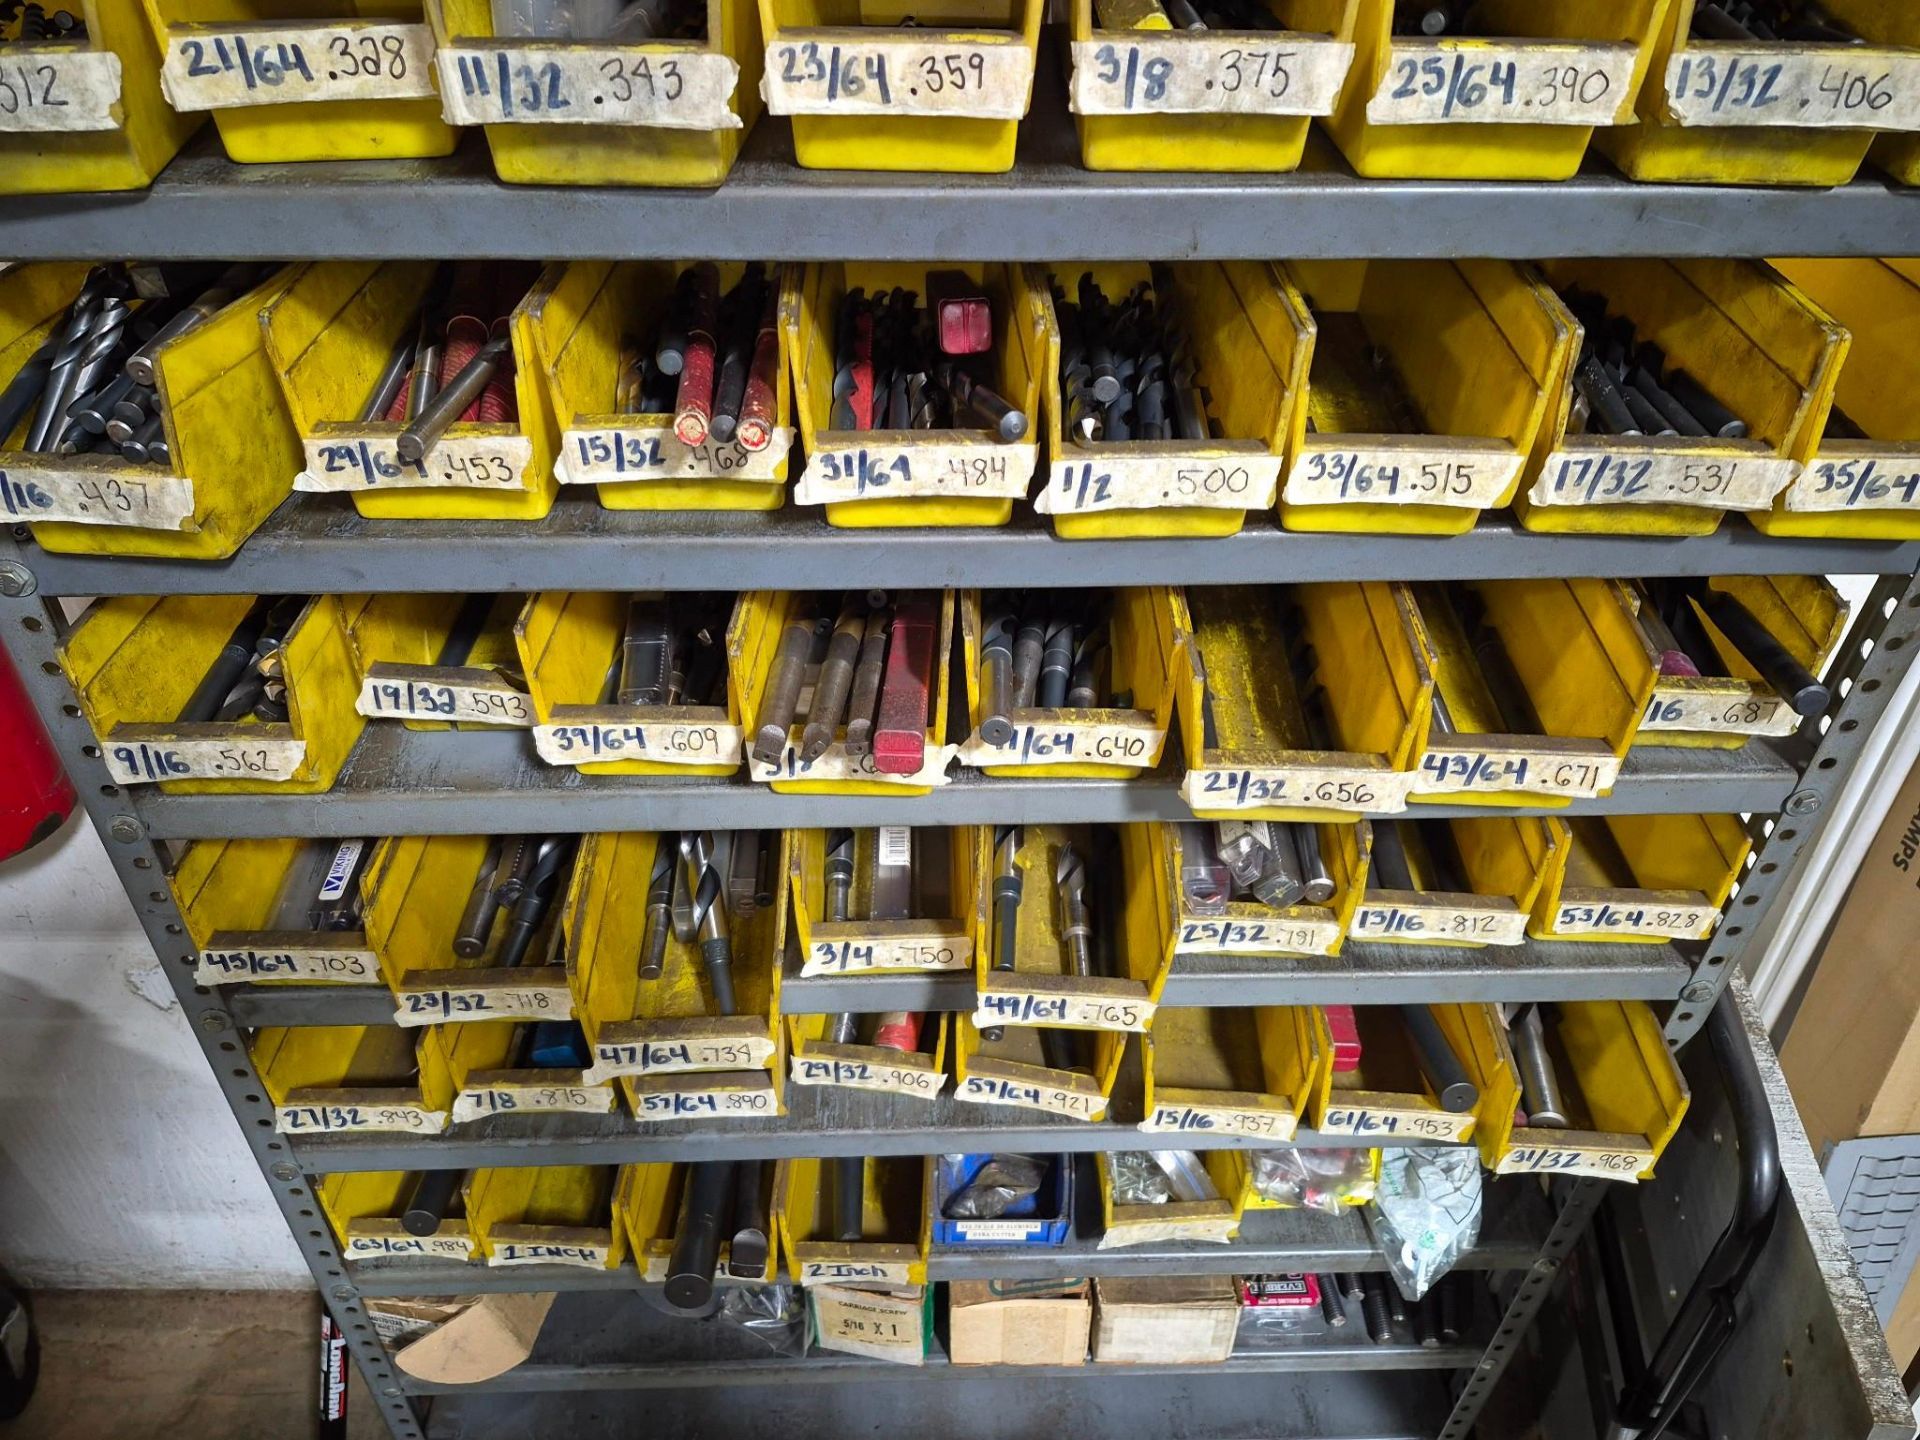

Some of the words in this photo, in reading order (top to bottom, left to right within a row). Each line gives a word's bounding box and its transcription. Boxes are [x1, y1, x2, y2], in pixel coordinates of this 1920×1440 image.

[180, 35, 314, 91] 21/64
[329, 35, 407, 80] .328
[778, 42, 891, 104] 23/64
[910, 52, 985, 96] .359
[1094, 44, 1174, 109] 3/8
[1205, 50, 1296, 98] .375
[459, 52, 570, 118] 11/32
[592, 56, 683, 102] .343
[1391, 54, 1517, 117] 25/64
[1523, 65, 1610, 107] .390
[1675, 57, 1783, 115] 13/32
[1799, 64, 1894, 110] .406
[578, 431, 667, 472] 15/32
[443, 453, 513, 483] .453
[938, 456, 1006, 486] .484
[1307, 453, 1401, 497] 33/64
[1409, 462, 1477, 494] .515
[1554, 454, 1653, 500] 17/32
[1664, 461, 1738, 496] .531
[1814, 460, 1920, 506] 35/64
[78, 480, 150, 512] .437
[1063, 462, 1112, 508] 1/2
[1163, 466, 1250, 498] .500
[371, 681, 457, 715] 19/32
[471, 692, 528, 719] .593
[1710, 701, 1779, 726] .687
[551, 724, 646, 755] 39/64
[663, 726, 720, 755] .609
[1085, 737, 1146, 759] .640
[114, 744, 192, 781] 9/16
[215, 749, 280, 776] .562
[1421, 751, 1528, 787] 43/64
[1539, 764, 1600, 791] .671
[1203, 770, 1288, 805] 21/32
[1302, 781, 1375, 804] .656
[330, 846, 351, 876] VIKING
[1359, 907, 1425, 933] 13/16
[1439, 916, 1497, 933] .812
[1559, 906, 1644, 929] 53/64
[1645, 911, 1700, 929] .828
[1183, 922, 1270, 948] 25/32
[206, 951, 298, 974] 45/64
[309, 955, 367, 976] .703
[819, 941, 873, 969] 3/4
[894, 945, 954, 964] .750
[405, 991, 494, 1017] 23/32
[504, 992, 550, 1010] .718
[983, 995, 1068, 1022] 49/64
[1082, 1003, 1138, 1027] .765
[600, 1043, 692, 1070] 47/64
[702, 1042, 752, 1064] .734
[801, 1061, 873, 1083] 29/32
[882, 1070, 930, 1089] .906
[465, 1089, 517, 1111] 7/8
[534, 1088, 587, 1106] .875
[643, 1092, 717, 1116] 57/64
[725, 1091, 767, 1111] .890
[967, 1077, 1040, 1104] 59/64
[1047, 1092, 1090, 1113] .921
[283, 1107, 367, 1131] 27/32
[378, 1110, 424, 1127] .843
[1154, 1108, 1215, 1130] 15/16
[1225, 1114, 1276, 1133] .937
[1327, 1110, 1398, 1137] 61/64
[1405, 1118, 1454, 1137] .953
[1511, 1149, 1582, 1170] 31/32
[1590, 1153, 1639, 1171] .968
[352, 1237, 425, 1253] 63/64
[431, 1240, 469, 1253] .984
[504, 1245, 518, 1261] 1
[528, 1245, 597, 1260] INCH
[808, 1264, 825, 1278] 2
[830, 1263, 889, 1278] Inch
[838, 1301, 877, 1313] CARRIAGE
[879, 1307, 908, 1316] SCREW
[843, 1319, 865, 1331] 5/16
[873, 1322, 884, 1336] X
[891, 1323, 898, 1337] 1
